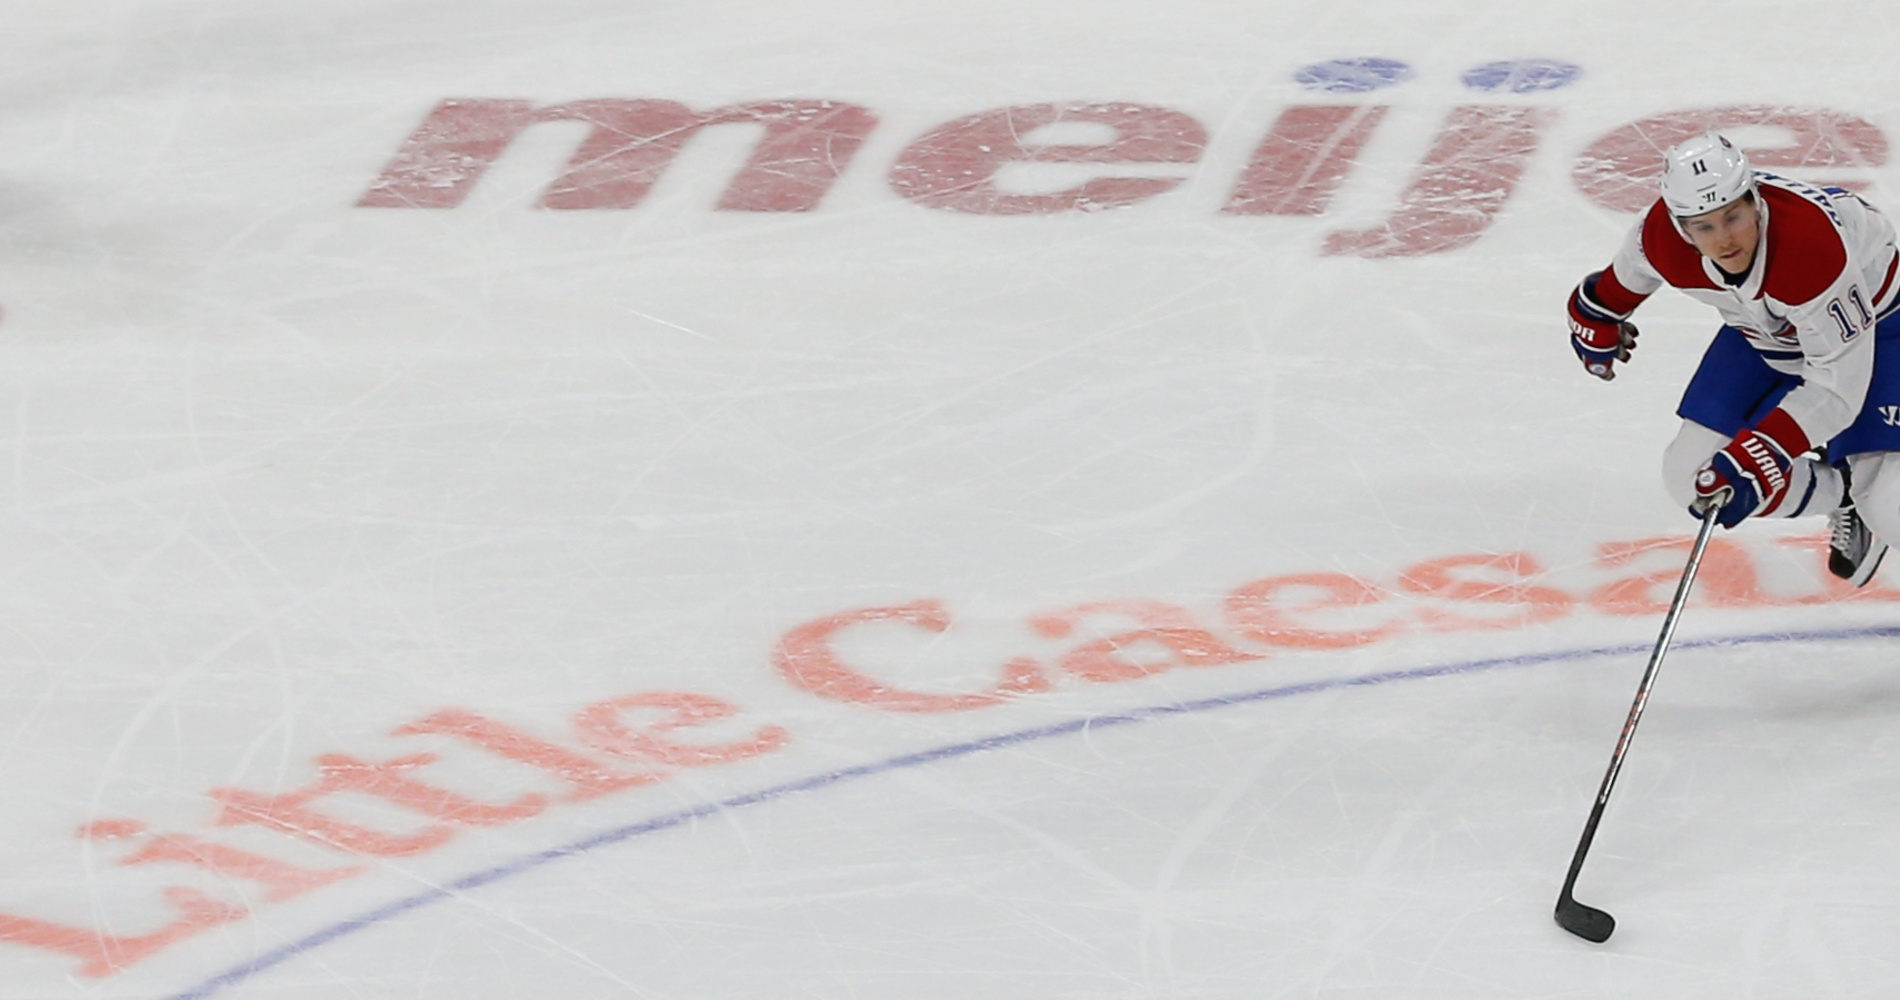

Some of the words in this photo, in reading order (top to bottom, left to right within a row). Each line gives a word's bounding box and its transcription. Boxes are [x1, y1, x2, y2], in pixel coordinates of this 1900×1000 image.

[1692, 159, 1708, 176] 11
[1827, 284, 1874, 343] 11
[0, 690, 790, 978] Little
